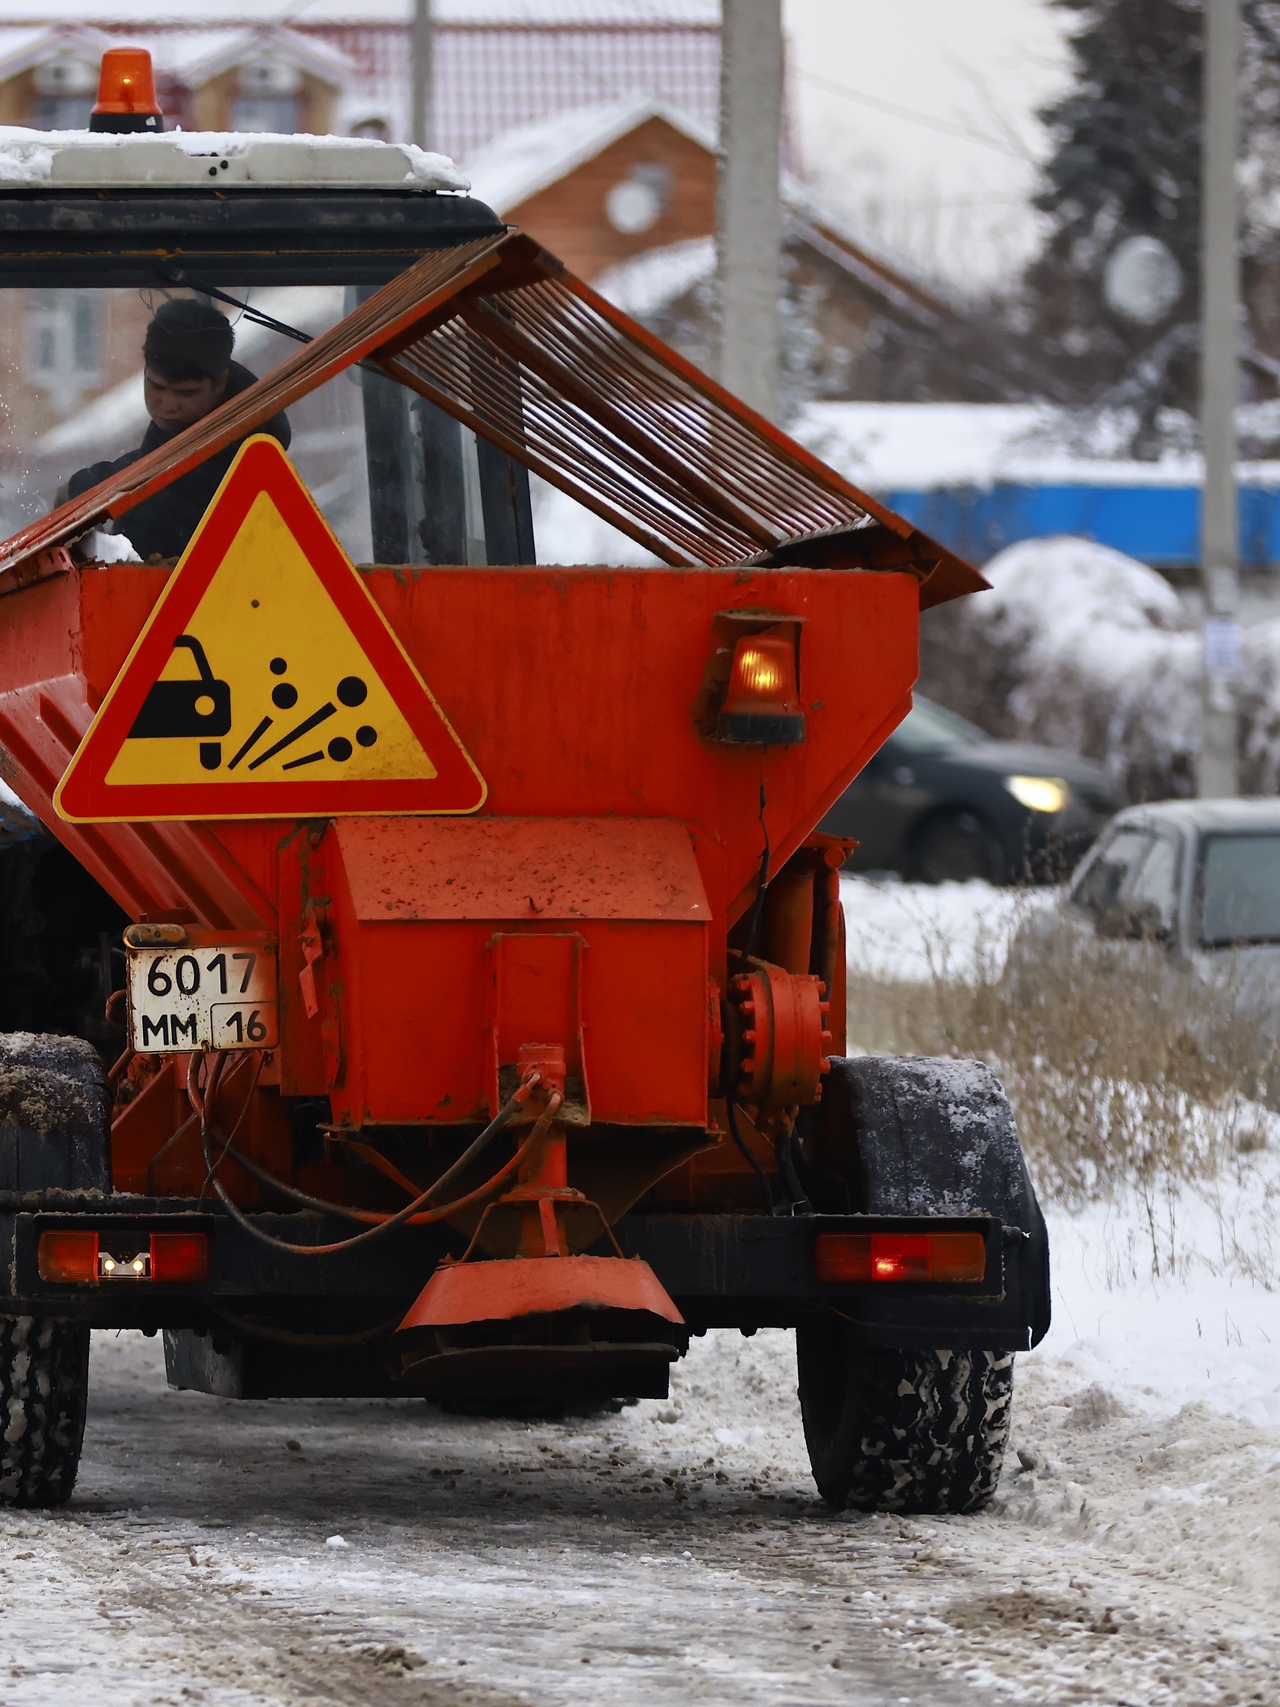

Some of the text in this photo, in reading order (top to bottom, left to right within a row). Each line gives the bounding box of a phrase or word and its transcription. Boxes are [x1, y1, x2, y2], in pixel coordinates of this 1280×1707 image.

[147, 953, 256, 997] 6017
[142, 1010, 267, 1046] ММ 16
